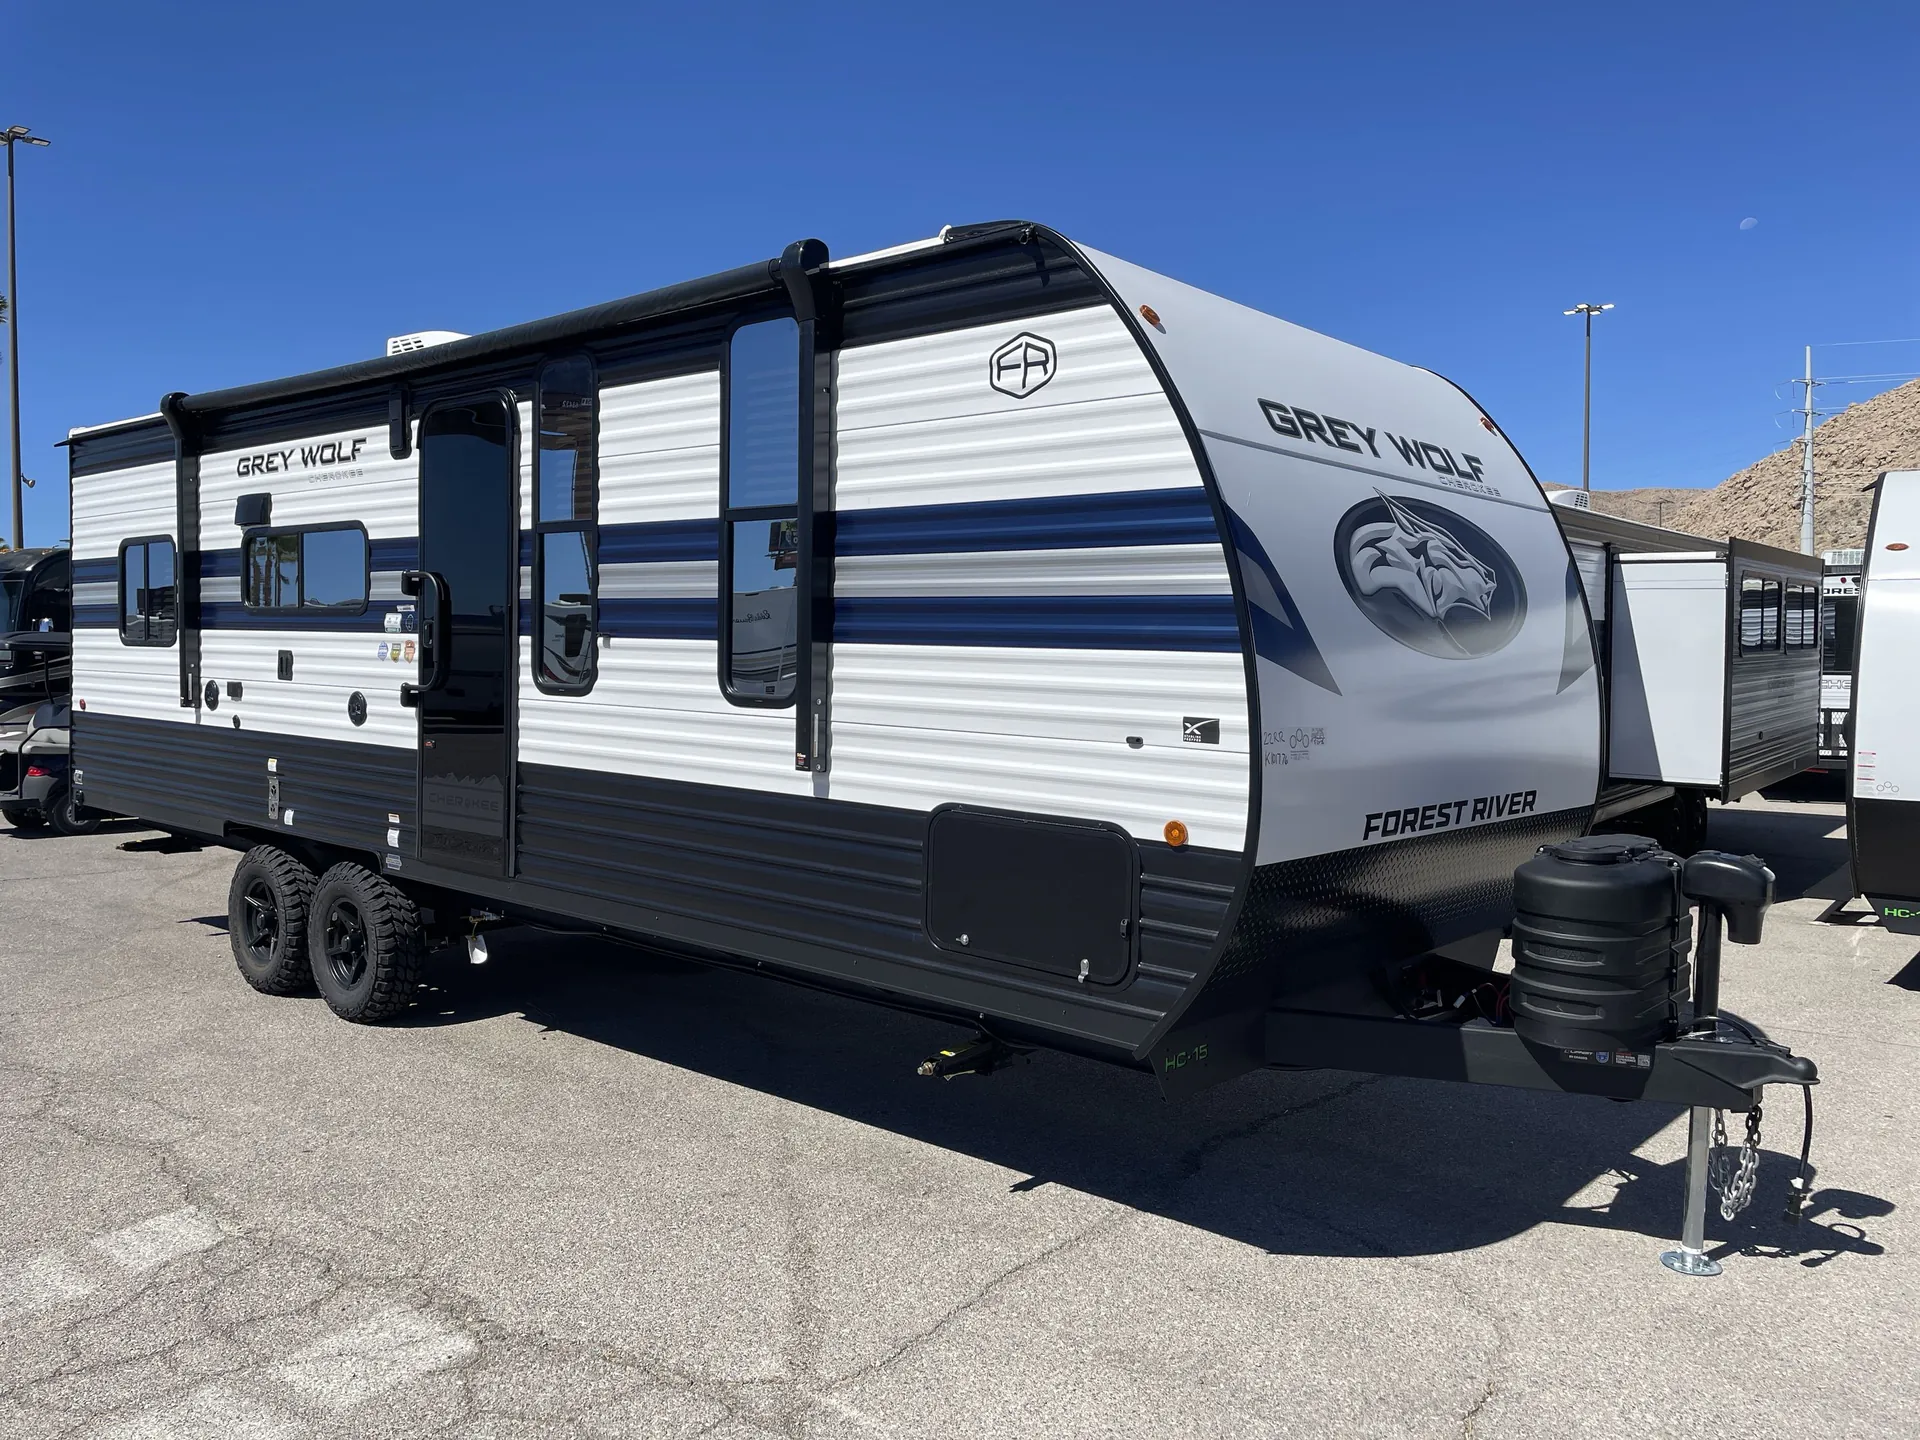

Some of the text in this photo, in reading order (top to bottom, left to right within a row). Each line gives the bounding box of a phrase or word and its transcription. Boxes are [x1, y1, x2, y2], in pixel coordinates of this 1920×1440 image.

[1257, 397, 1484, 483] GREY WOLF
[237, 437, 367, 477] GREY WOLF
[308, 468, 364, 484] CHEROKEE
[1438, 474, 1501, 497] CHEROKEE
[428, 792, 499, 812] CHEROKEE
[1362, 789, 1537, 841] FOREST RIVER
